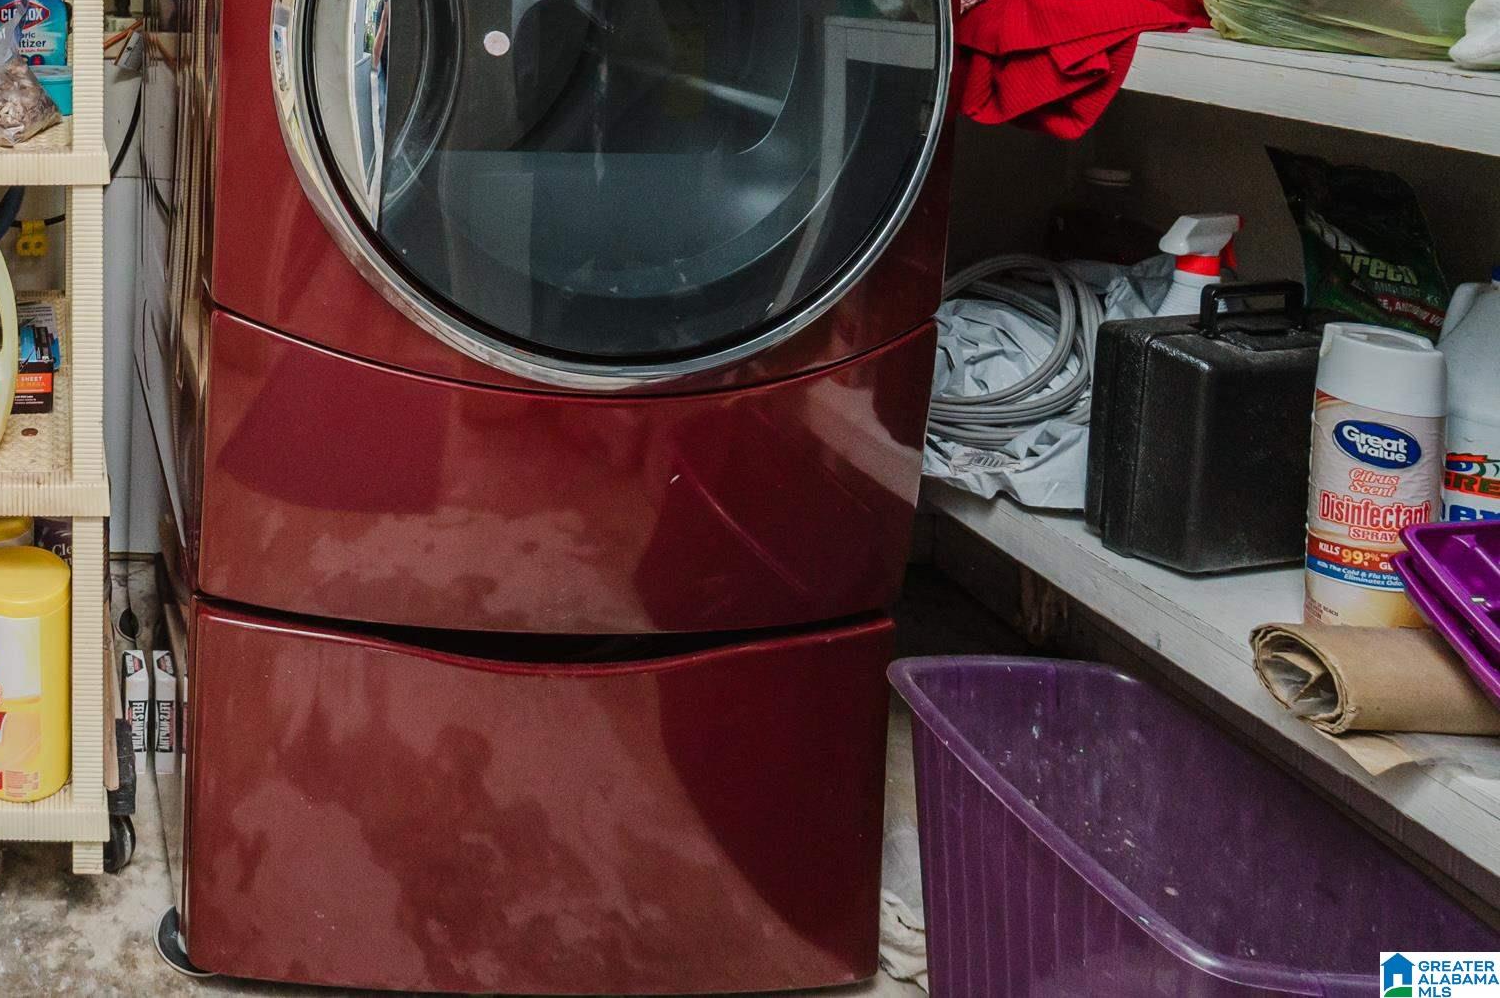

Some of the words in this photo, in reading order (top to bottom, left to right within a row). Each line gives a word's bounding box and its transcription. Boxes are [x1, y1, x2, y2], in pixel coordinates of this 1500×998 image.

[1342, 425, 1407, 453] Great
[1356, 442, 1407, 462] Value
[1349, 468, 1400, 486] Citrus
[1349, 480, 1397, 497] Scent
[1319, 490, 1431, 530] Disinfectant
[1349, 527, 1398, 543] SPRAY
[1318, 541, 1341, 556] KILLS
[1329, 564, 1342, 573] The
[1342, 566, 1360, 576] Cold
[1368, 571, 1380, 580] Flu
[1343, 573, 1385, 586] Eliminates
